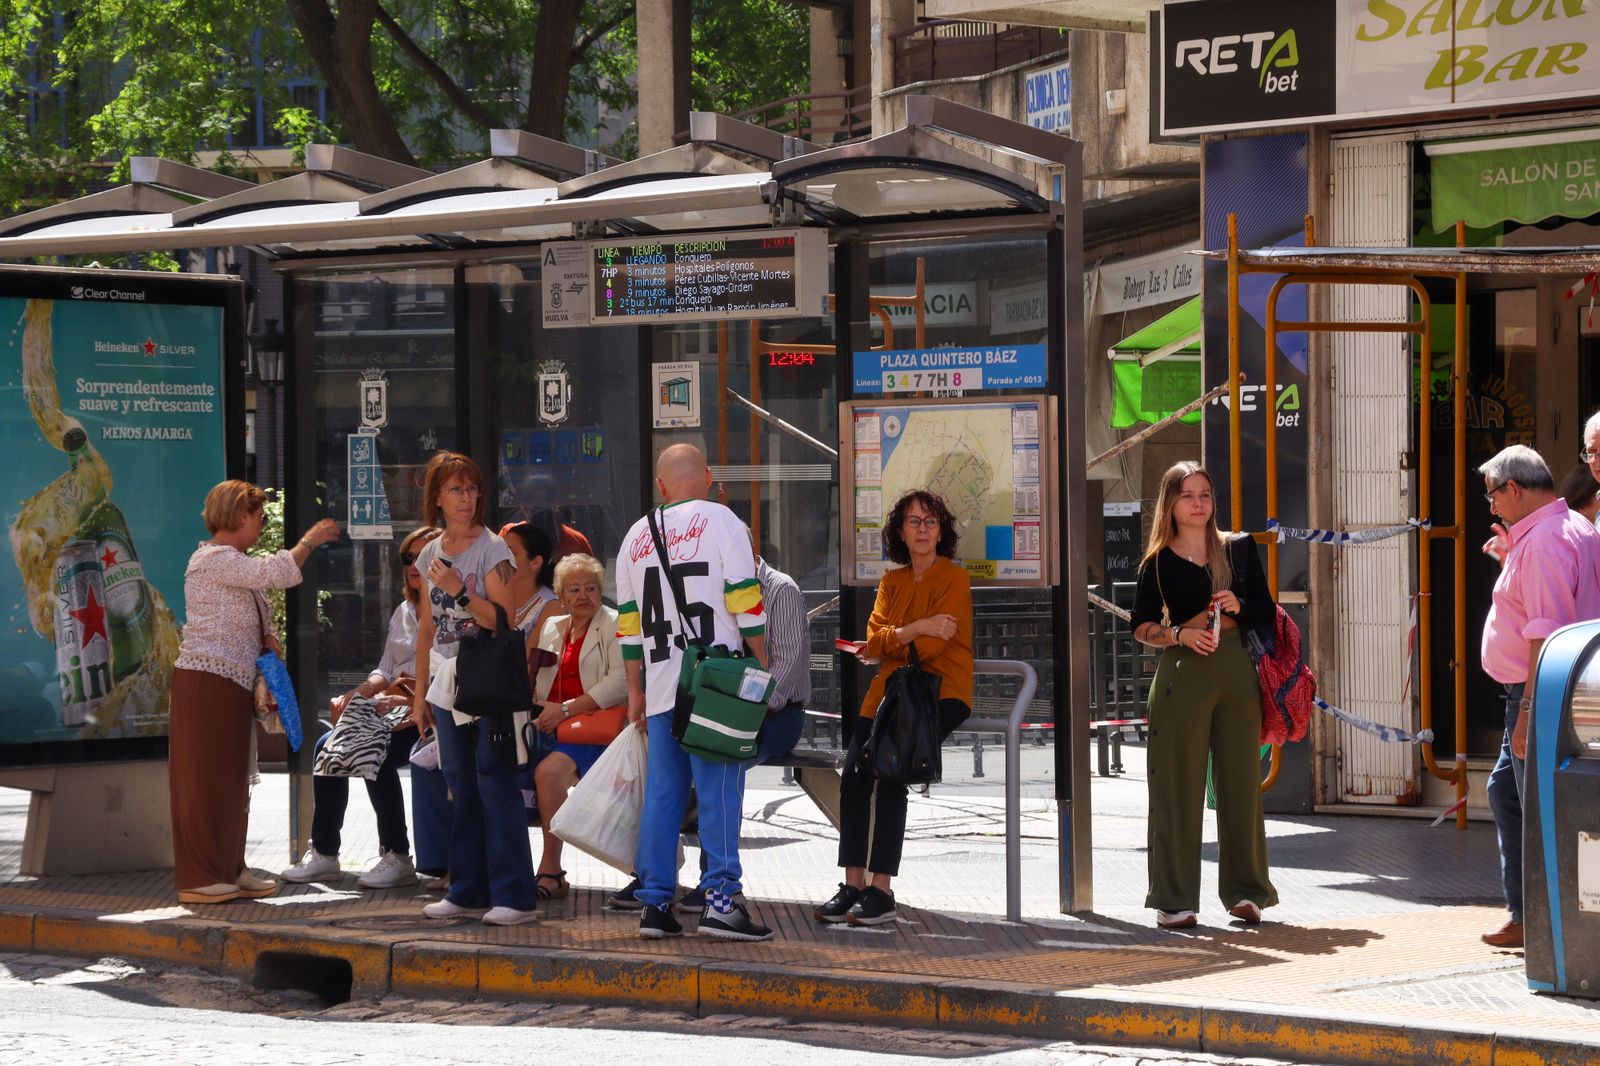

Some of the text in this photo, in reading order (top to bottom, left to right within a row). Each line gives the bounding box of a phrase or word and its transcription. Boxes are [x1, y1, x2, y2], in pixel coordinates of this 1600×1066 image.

[1175, 29, 1299, 88] RETA
[1424, 42, 1588, 90] BAR
[1265, 71, 1299, 94] bet
[1480, 158, 1597, 187] SALÓN DE
[631, 244, 663, 256] TIEMPO
[606, 253, 712, 267] 3 LLEGANDO Conquero
[601, 267, 618, 278] 7HP
[627, 267, 632, 276] 3
[634, 266, 666, 276] minutos
[674, 263, 715, 274] Hospitales
[606, 278, 612, 288] 4
[627, 277, 632, 287] 3
[635, 277, 666, 286] minutos
[674, 274, 696, 285] Pérez
[760, 270, 791, 280] Mortes
[84, 288, 145, 301] Clear Channel
[606, 289, 613, 299] 8
[627, 288, 632, 298] 9
[635, 288, 667, 298] minutos
[674, 285, 698, 296] Diego
[607, 299, 613, 309] 3
[631, 298, 645, 307] bus
[647, 297, 657, 306] 17
[660, 296, 674, 305] min
[675, 295, 712, 306] Conquero
[607, 309, 613, 317] 7
[95, 341, 196, 355] Heineken SILVER
[880, 348, 1017, 368] PLAZA QUINTERO BÁEZ
[76, 378, 215, 397] Sorprendentemente
[887, 374, 895, 389] 3
[900, 373, 909, 388] 4
[913, 373, 923, 388] 7
[928, 373, 948, 387] 7H
[953, 372, 962, 387] 8
[988, 377, 1013, 385] Parada
[1024, 375, 1042, 384] 6013
[79, 397, 213, 415] suave y refrescante
[1275, 411, 1300, 427] bet
[103, 427, 193, 440] MENOS AMARGA
[641, 561, 716, 664] 45
